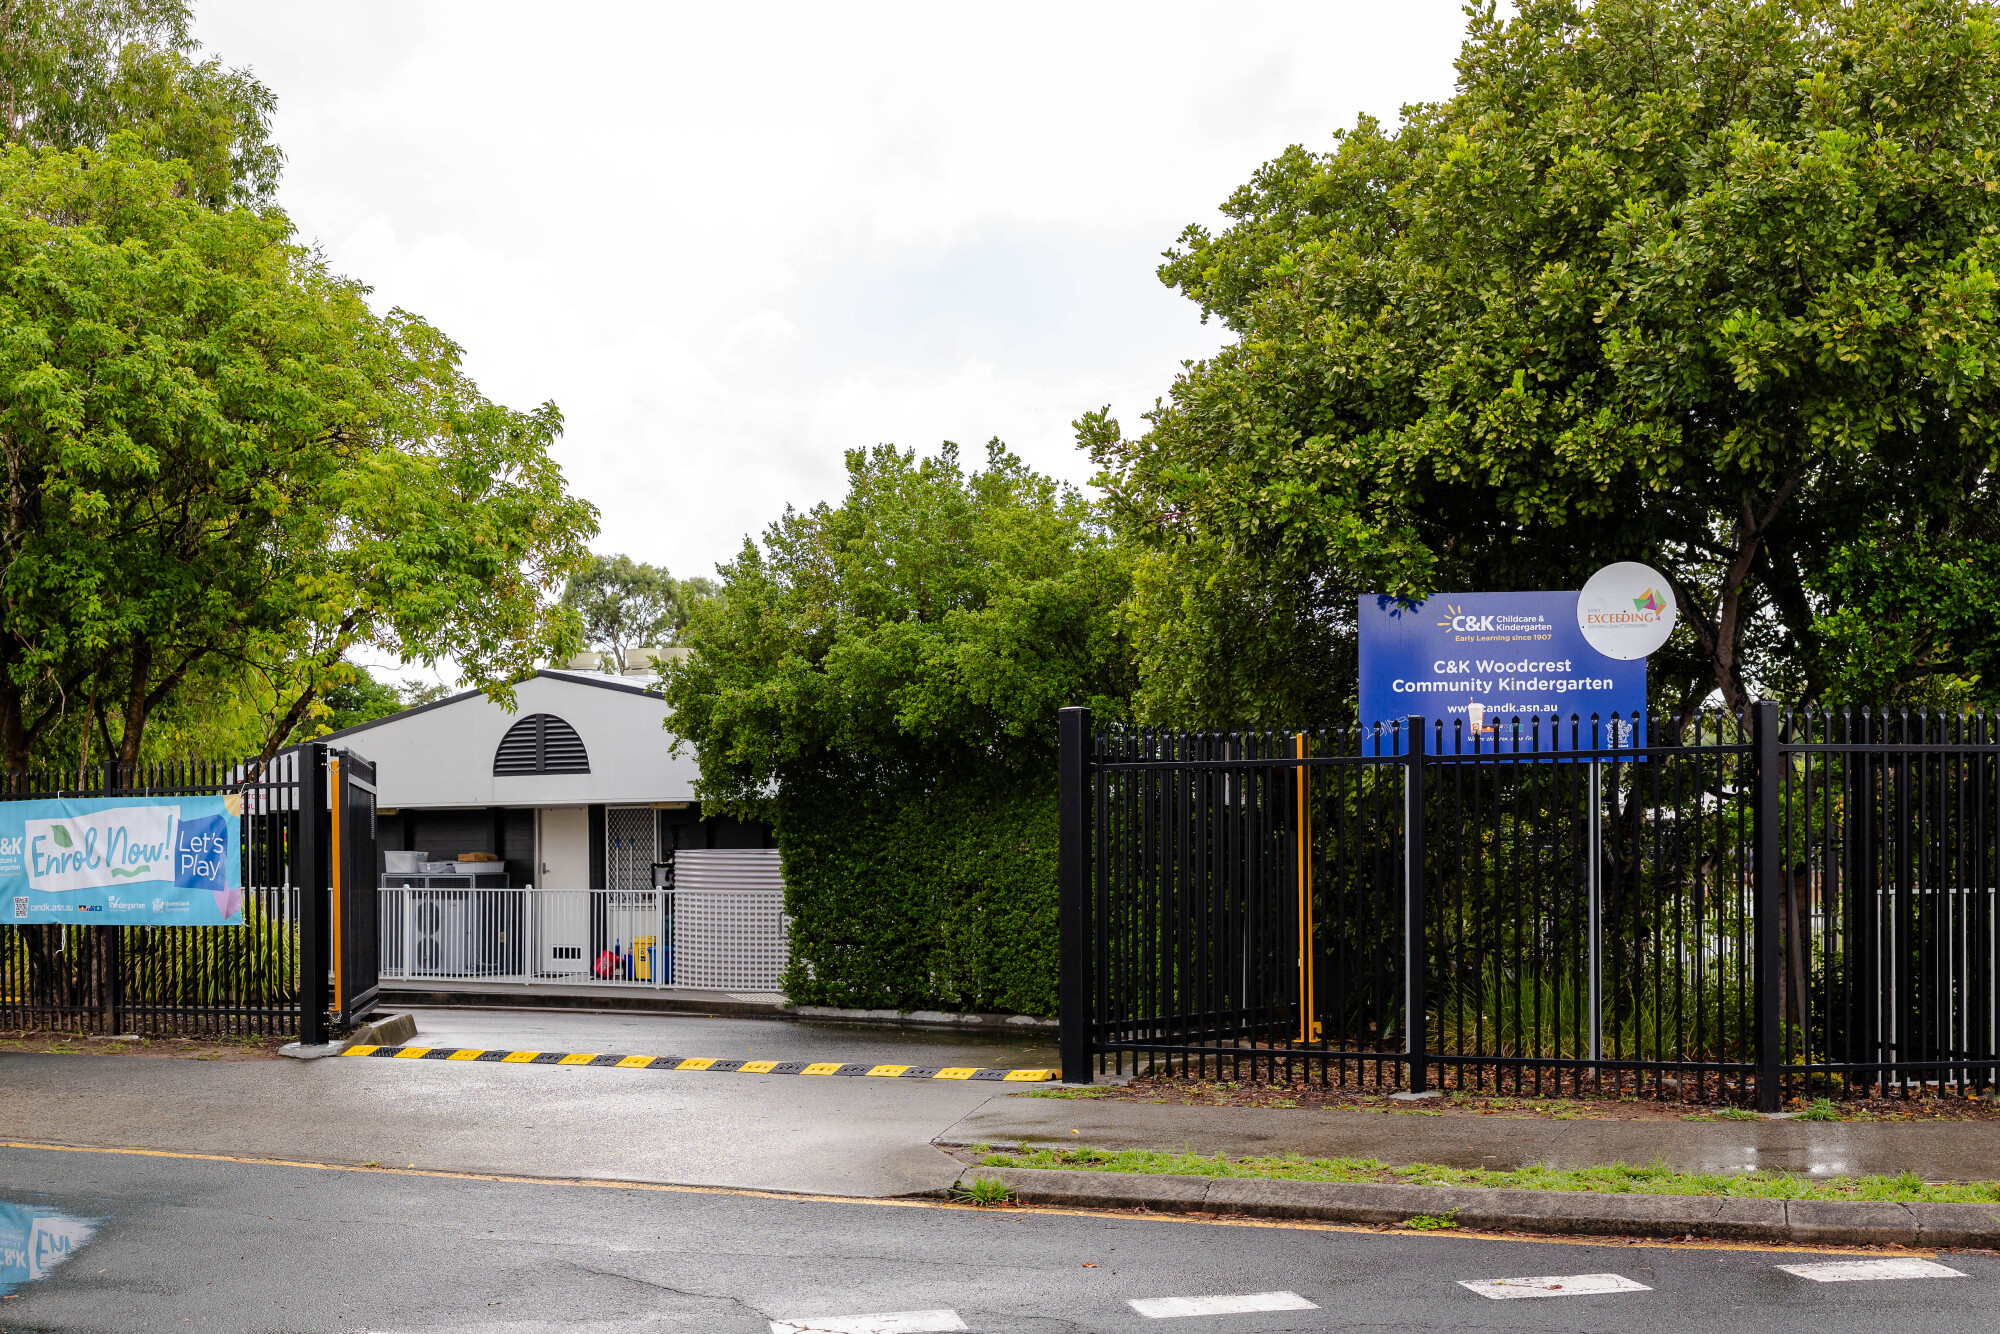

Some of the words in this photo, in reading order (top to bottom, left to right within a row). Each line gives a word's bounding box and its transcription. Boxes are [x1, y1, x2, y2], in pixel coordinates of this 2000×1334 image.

[1452, 615, 1495, 632] C&K
[1496, 615, 1537, 623] Childcare
[1587, 612, 1653, 624] EXCEEDING
[1496, 623, 1552, 632] Kindergarten
[1476, 634, 1511, 642] Learning
[1433, 660, 1470, 674] C&K
[1476, 659, 1572, 673] Woodcrest
[1392, 679, 1493, 694] Community
[1498, 677, 1614, 693] Kindergarten
[1447, 702, 1559, 714] wwcandk.asn.au
[0, 837, 23, 855] &K
[32, 827, 101, 878] Enrol
[107, 815, 173, 867] Now!
[179, 830, 224, 854] Let's
[181, 854, 221, 881] Play
[30, 903, 74, 912] candk.asn.au
